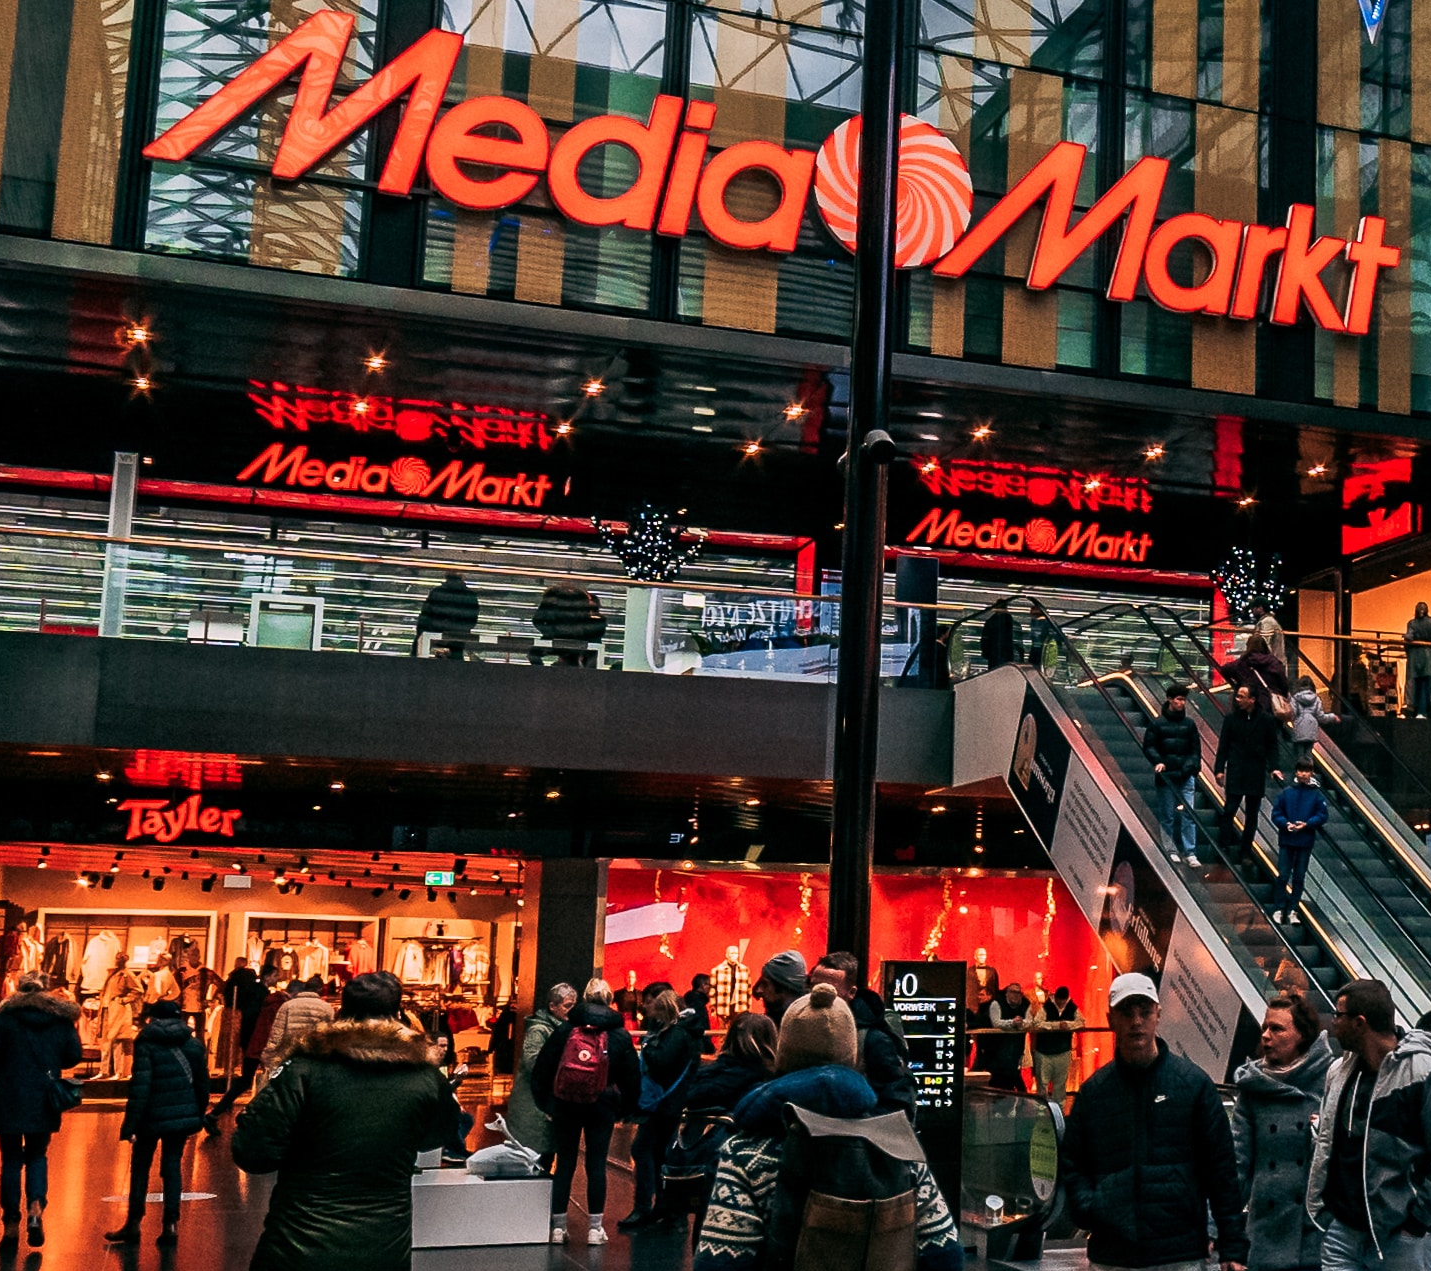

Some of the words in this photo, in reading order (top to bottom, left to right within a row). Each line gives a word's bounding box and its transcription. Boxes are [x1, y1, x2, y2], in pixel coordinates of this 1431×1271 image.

[142, 9, 816, 252] Media
[933, 142, 1401, 335] Markt
[236, 442, 392, 493] Media
[420, 460, 553, 507] Markt
[906, 508, 1026, 552] Media
[1050, 521, 1153, 562] Markt
[116, 793, 243, 843] Tayler
[893, 1002, 936, 1012] VORWERK
